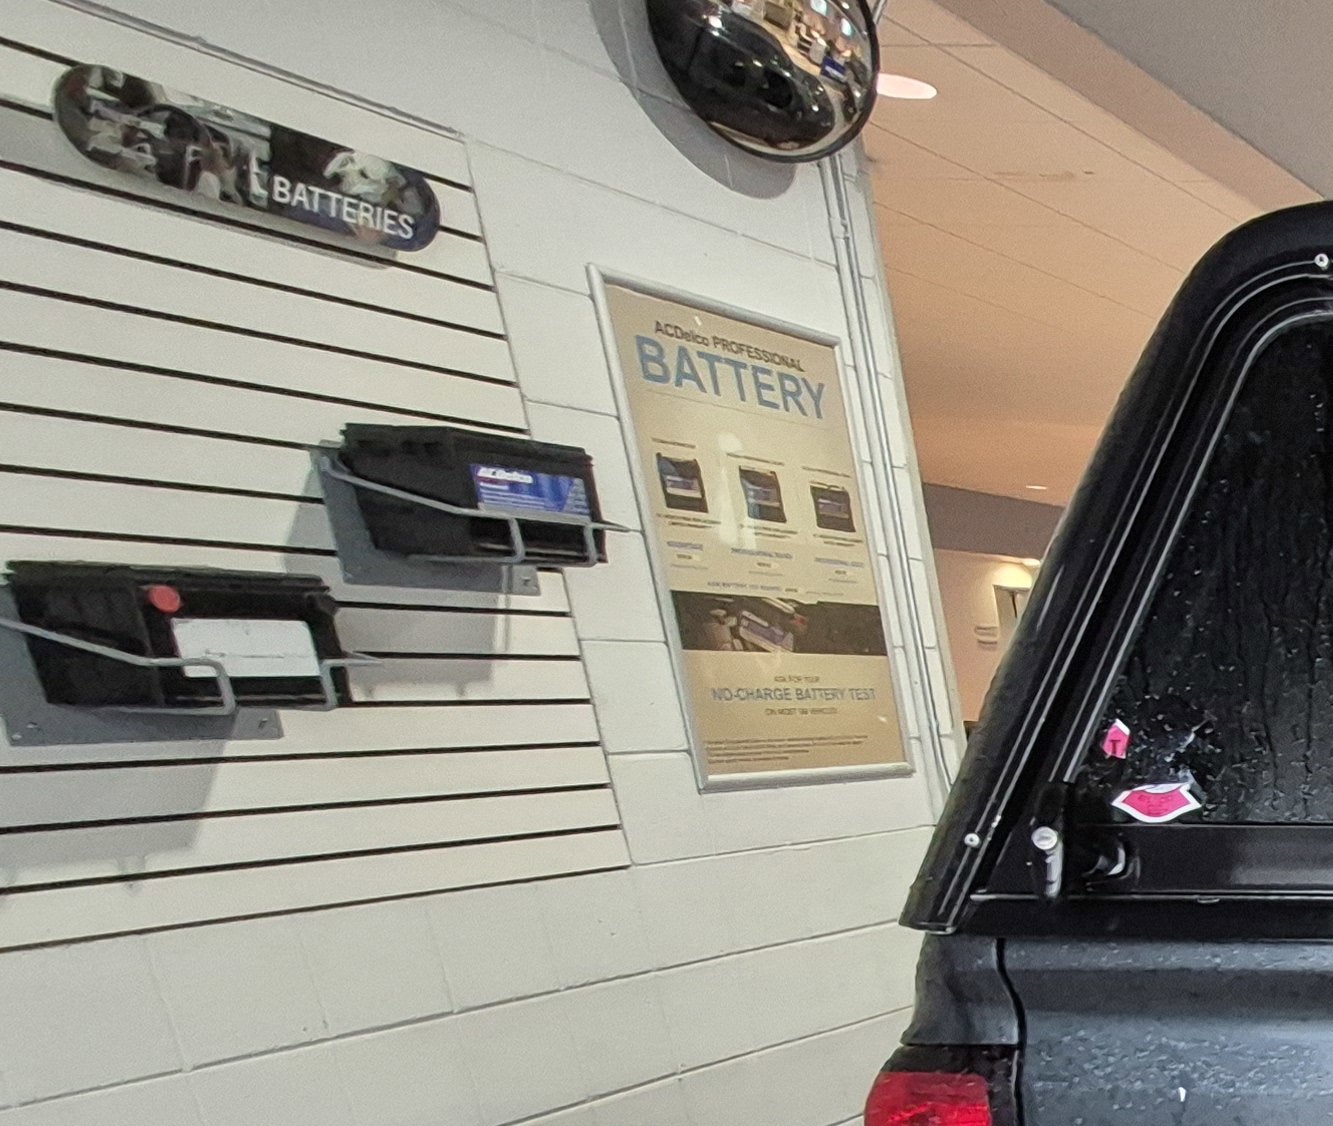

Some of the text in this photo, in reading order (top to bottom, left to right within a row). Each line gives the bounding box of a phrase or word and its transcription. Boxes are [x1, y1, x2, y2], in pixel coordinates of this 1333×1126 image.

[272, 174, 415, 240] BATTERIES
[655, 320, 805, 373] ACDelco PROFESSIONAL
[634, 334, 825, 419] BATTERY
[712, 687, 877, 702] NO-CHARGE BATTERY TEST
